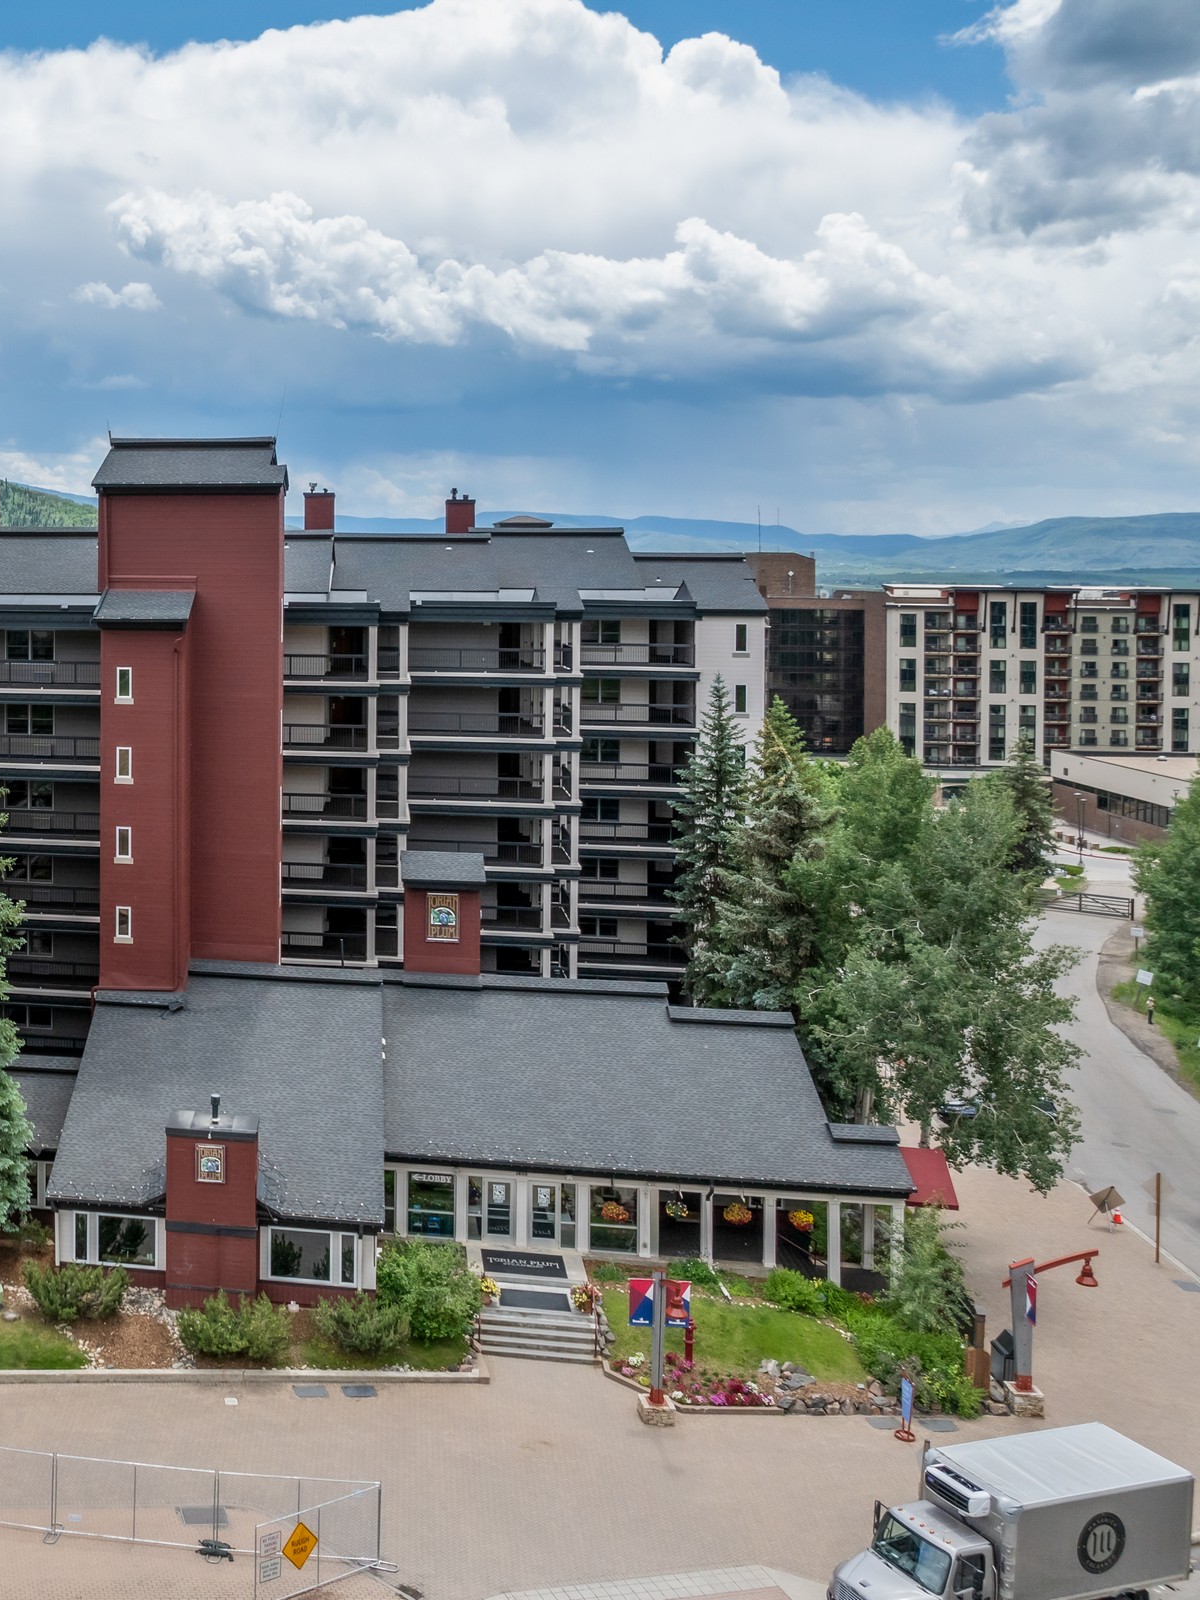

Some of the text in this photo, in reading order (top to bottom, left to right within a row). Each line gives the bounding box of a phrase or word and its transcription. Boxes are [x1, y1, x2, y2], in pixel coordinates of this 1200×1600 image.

[431, 926, 455, 937] PLUM
[422, 1174, 452, 1184] LOBBY
[486, 1256, 560, 1269] TORIAN PLUM
[291, 1536, 310, 1548] ROUGH
[292, 1545, 308, 1556] ROAD
